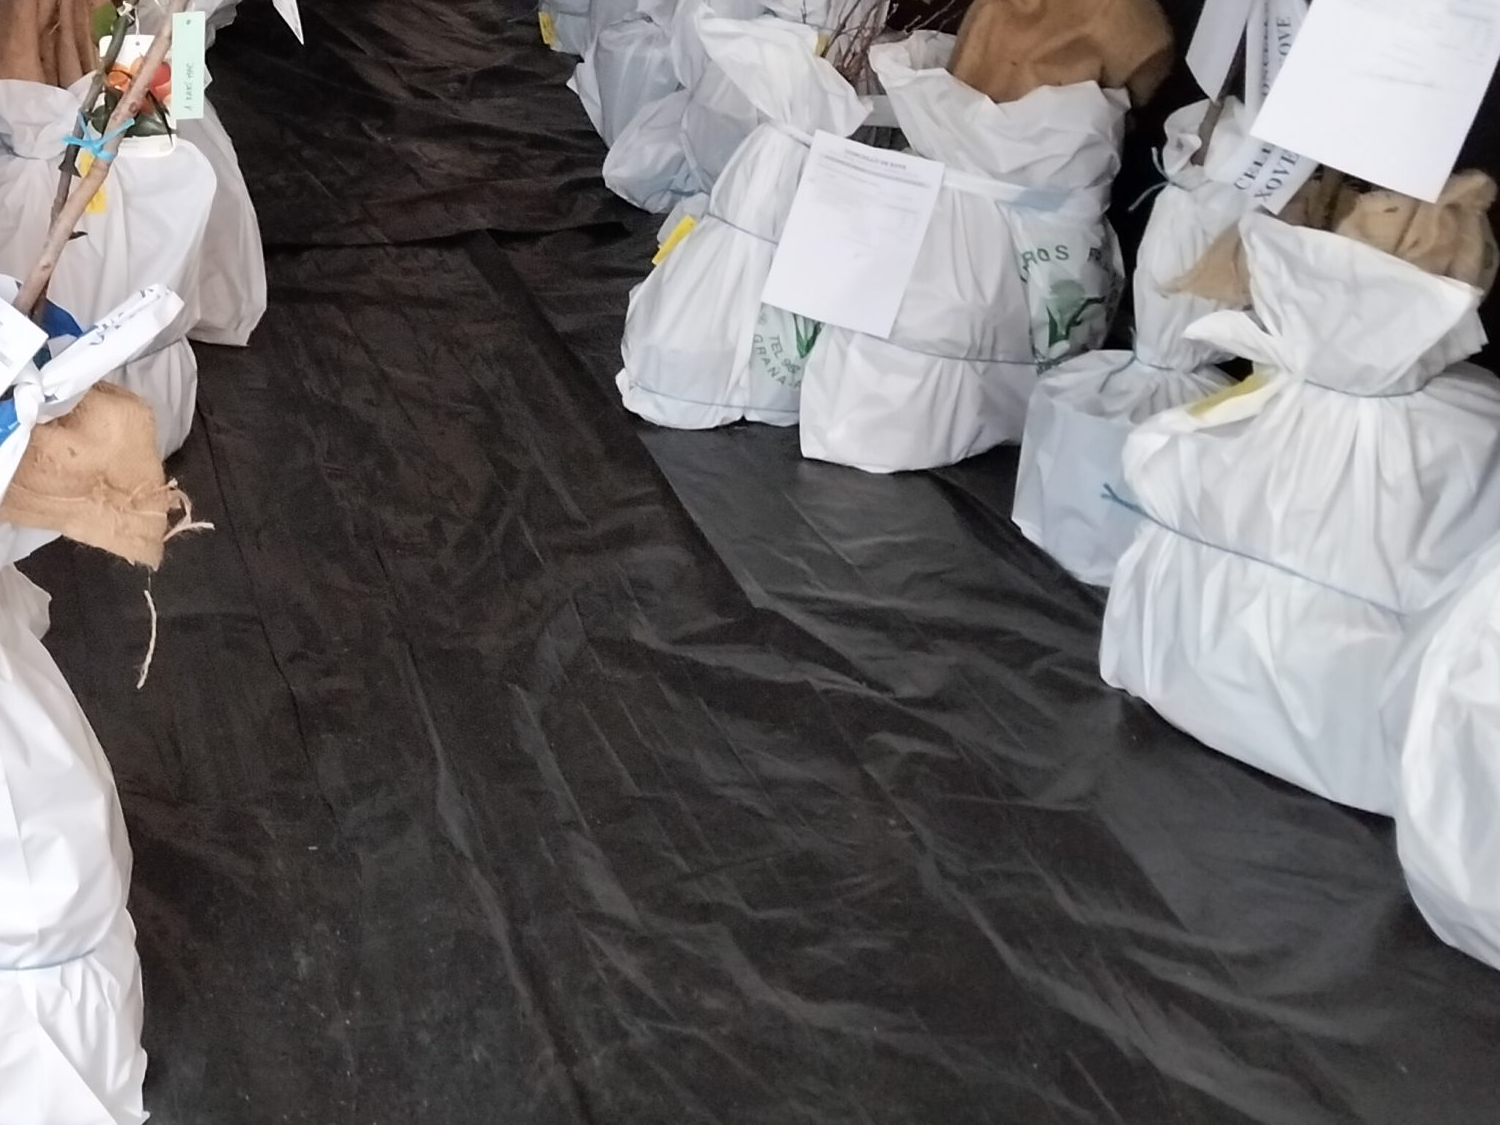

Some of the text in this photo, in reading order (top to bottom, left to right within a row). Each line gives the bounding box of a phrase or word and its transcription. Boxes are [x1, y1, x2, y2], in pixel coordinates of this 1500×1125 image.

[1276, 16, 1292, 57] OVE
[1233, 147, 1272, 191] CELL
[1253, 151, 1300, 204] XOVE
[768, 335, 783, 359] TEL
